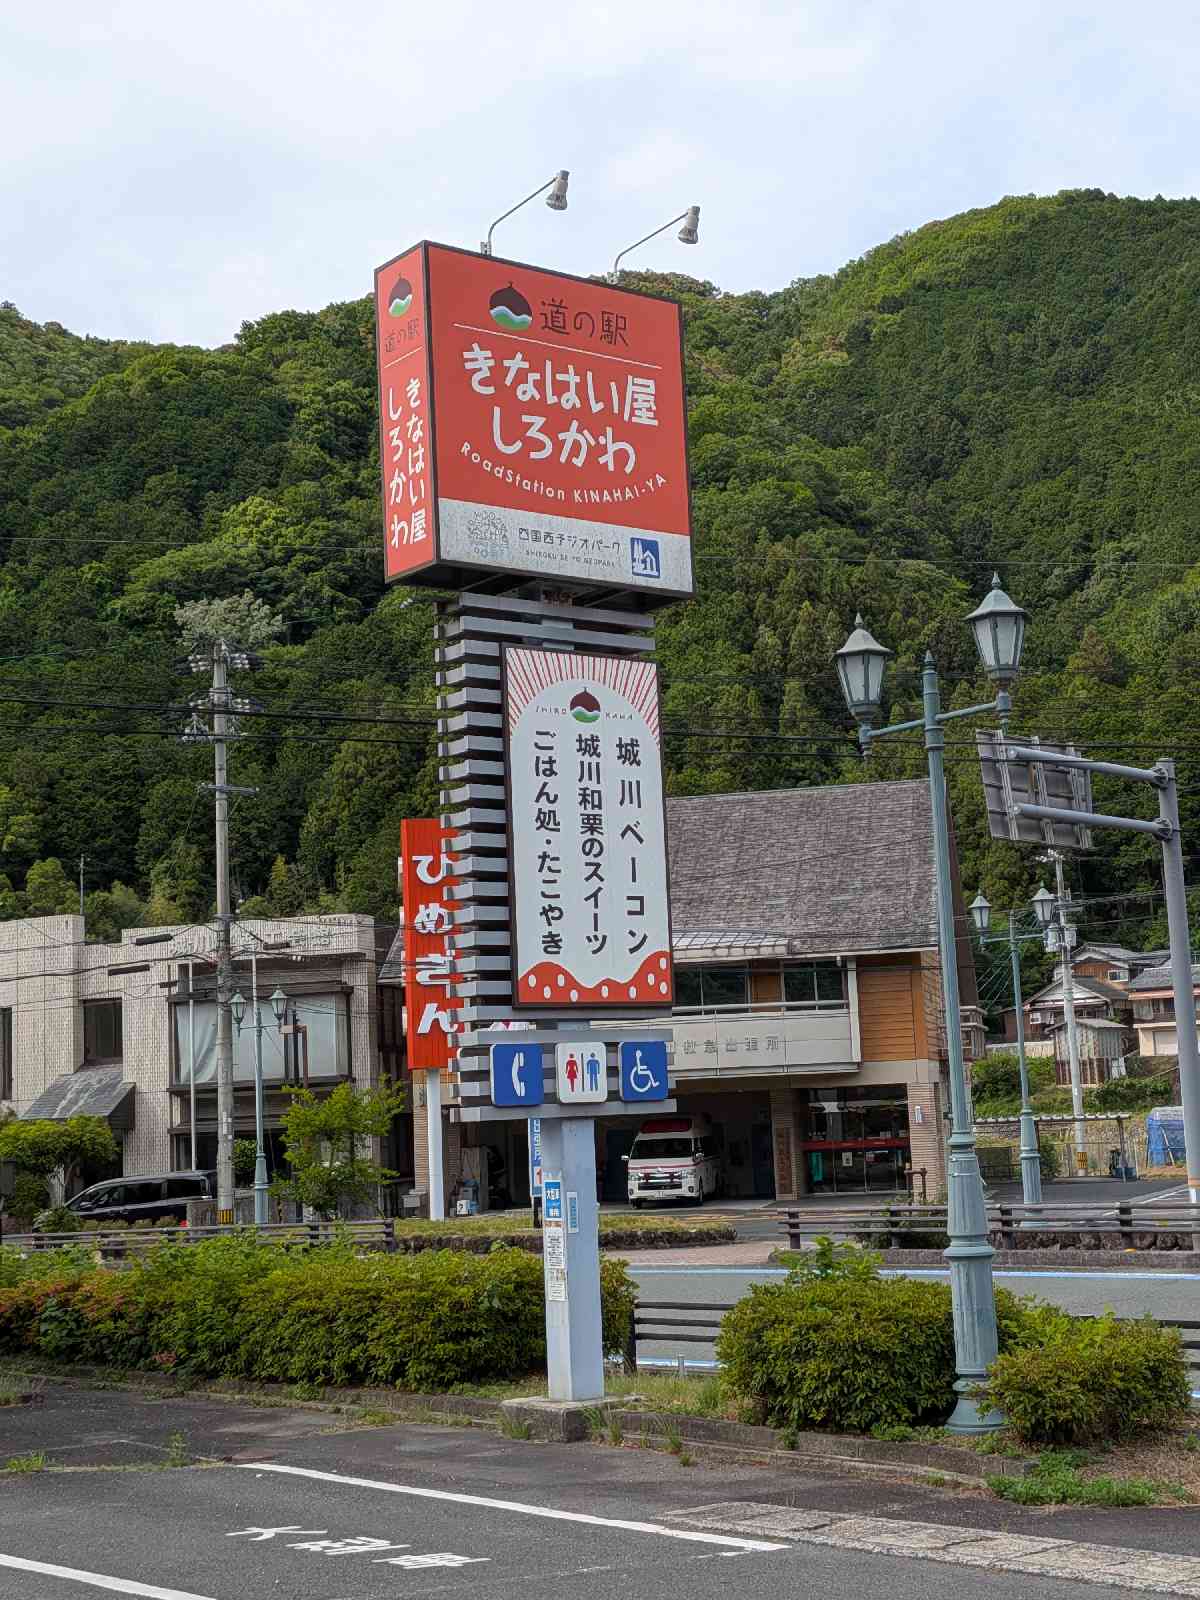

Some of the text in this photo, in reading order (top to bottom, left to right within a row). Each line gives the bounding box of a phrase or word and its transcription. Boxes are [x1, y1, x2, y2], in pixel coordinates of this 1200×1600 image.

[384, 317, 420, 353] 道の駅
[540, 298, 629, 347] 道の駅
[462, 342, 660, 427] きなはい屋
[388, 386, 409, 549] しろかわ
[406, 378, 427, 544] きなはい屋
[491, 405, 636, 474] しろかわ
[573, 473, 667, 504] KINAHAI-YA
[518, 527, 621, 553] 四国西予ジオパーク
[533, 728, 564, 957] ごはん処・たこやき
[575, 733, 608, 955] 城川和栗のスイーツ
[615, 736, 648, 955] 城川ベーコン
[225, 1525, 491, 1569] 大型車
